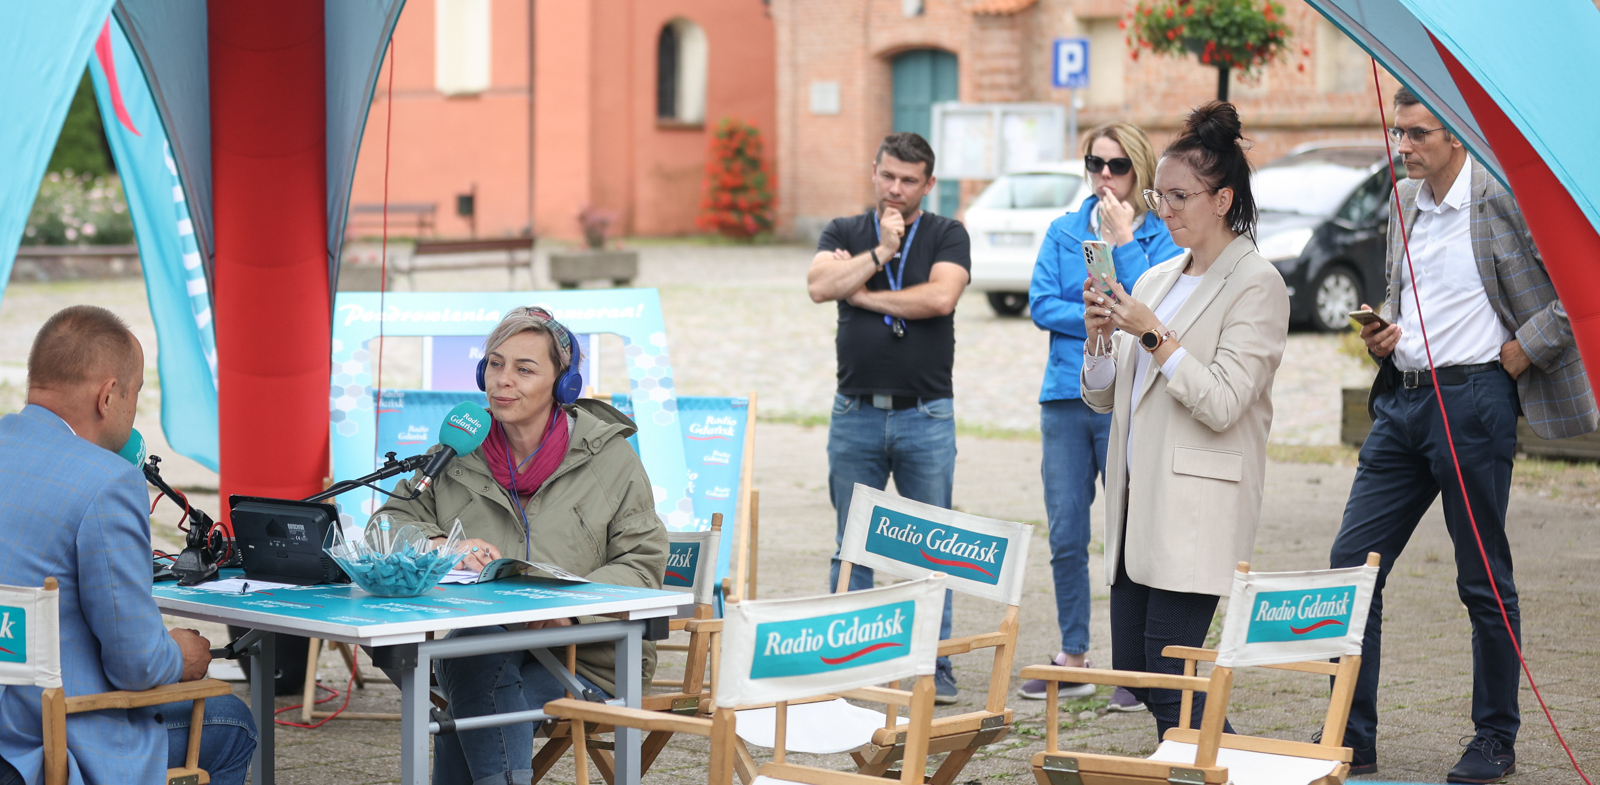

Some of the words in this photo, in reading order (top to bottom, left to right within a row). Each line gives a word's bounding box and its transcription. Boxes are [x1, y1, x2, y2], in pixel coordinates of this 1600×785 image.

[450, 414, 478, 435] Gdańsk
[462, 412, 482, 429] Radio
[689, 423, 735, 436] Gdańsk
[706, 415, 738, 426] Radio
[875, 516, 923, 545] Radio
[926, 528, 999, 564] Gdańsk
[1255, 600, 1296, 621] Radio
[1297, 592, 1350, 619] Gdańsk
[764, 628, 824, 656] Radio
[827, 608, 906, 648] Gdańsk
